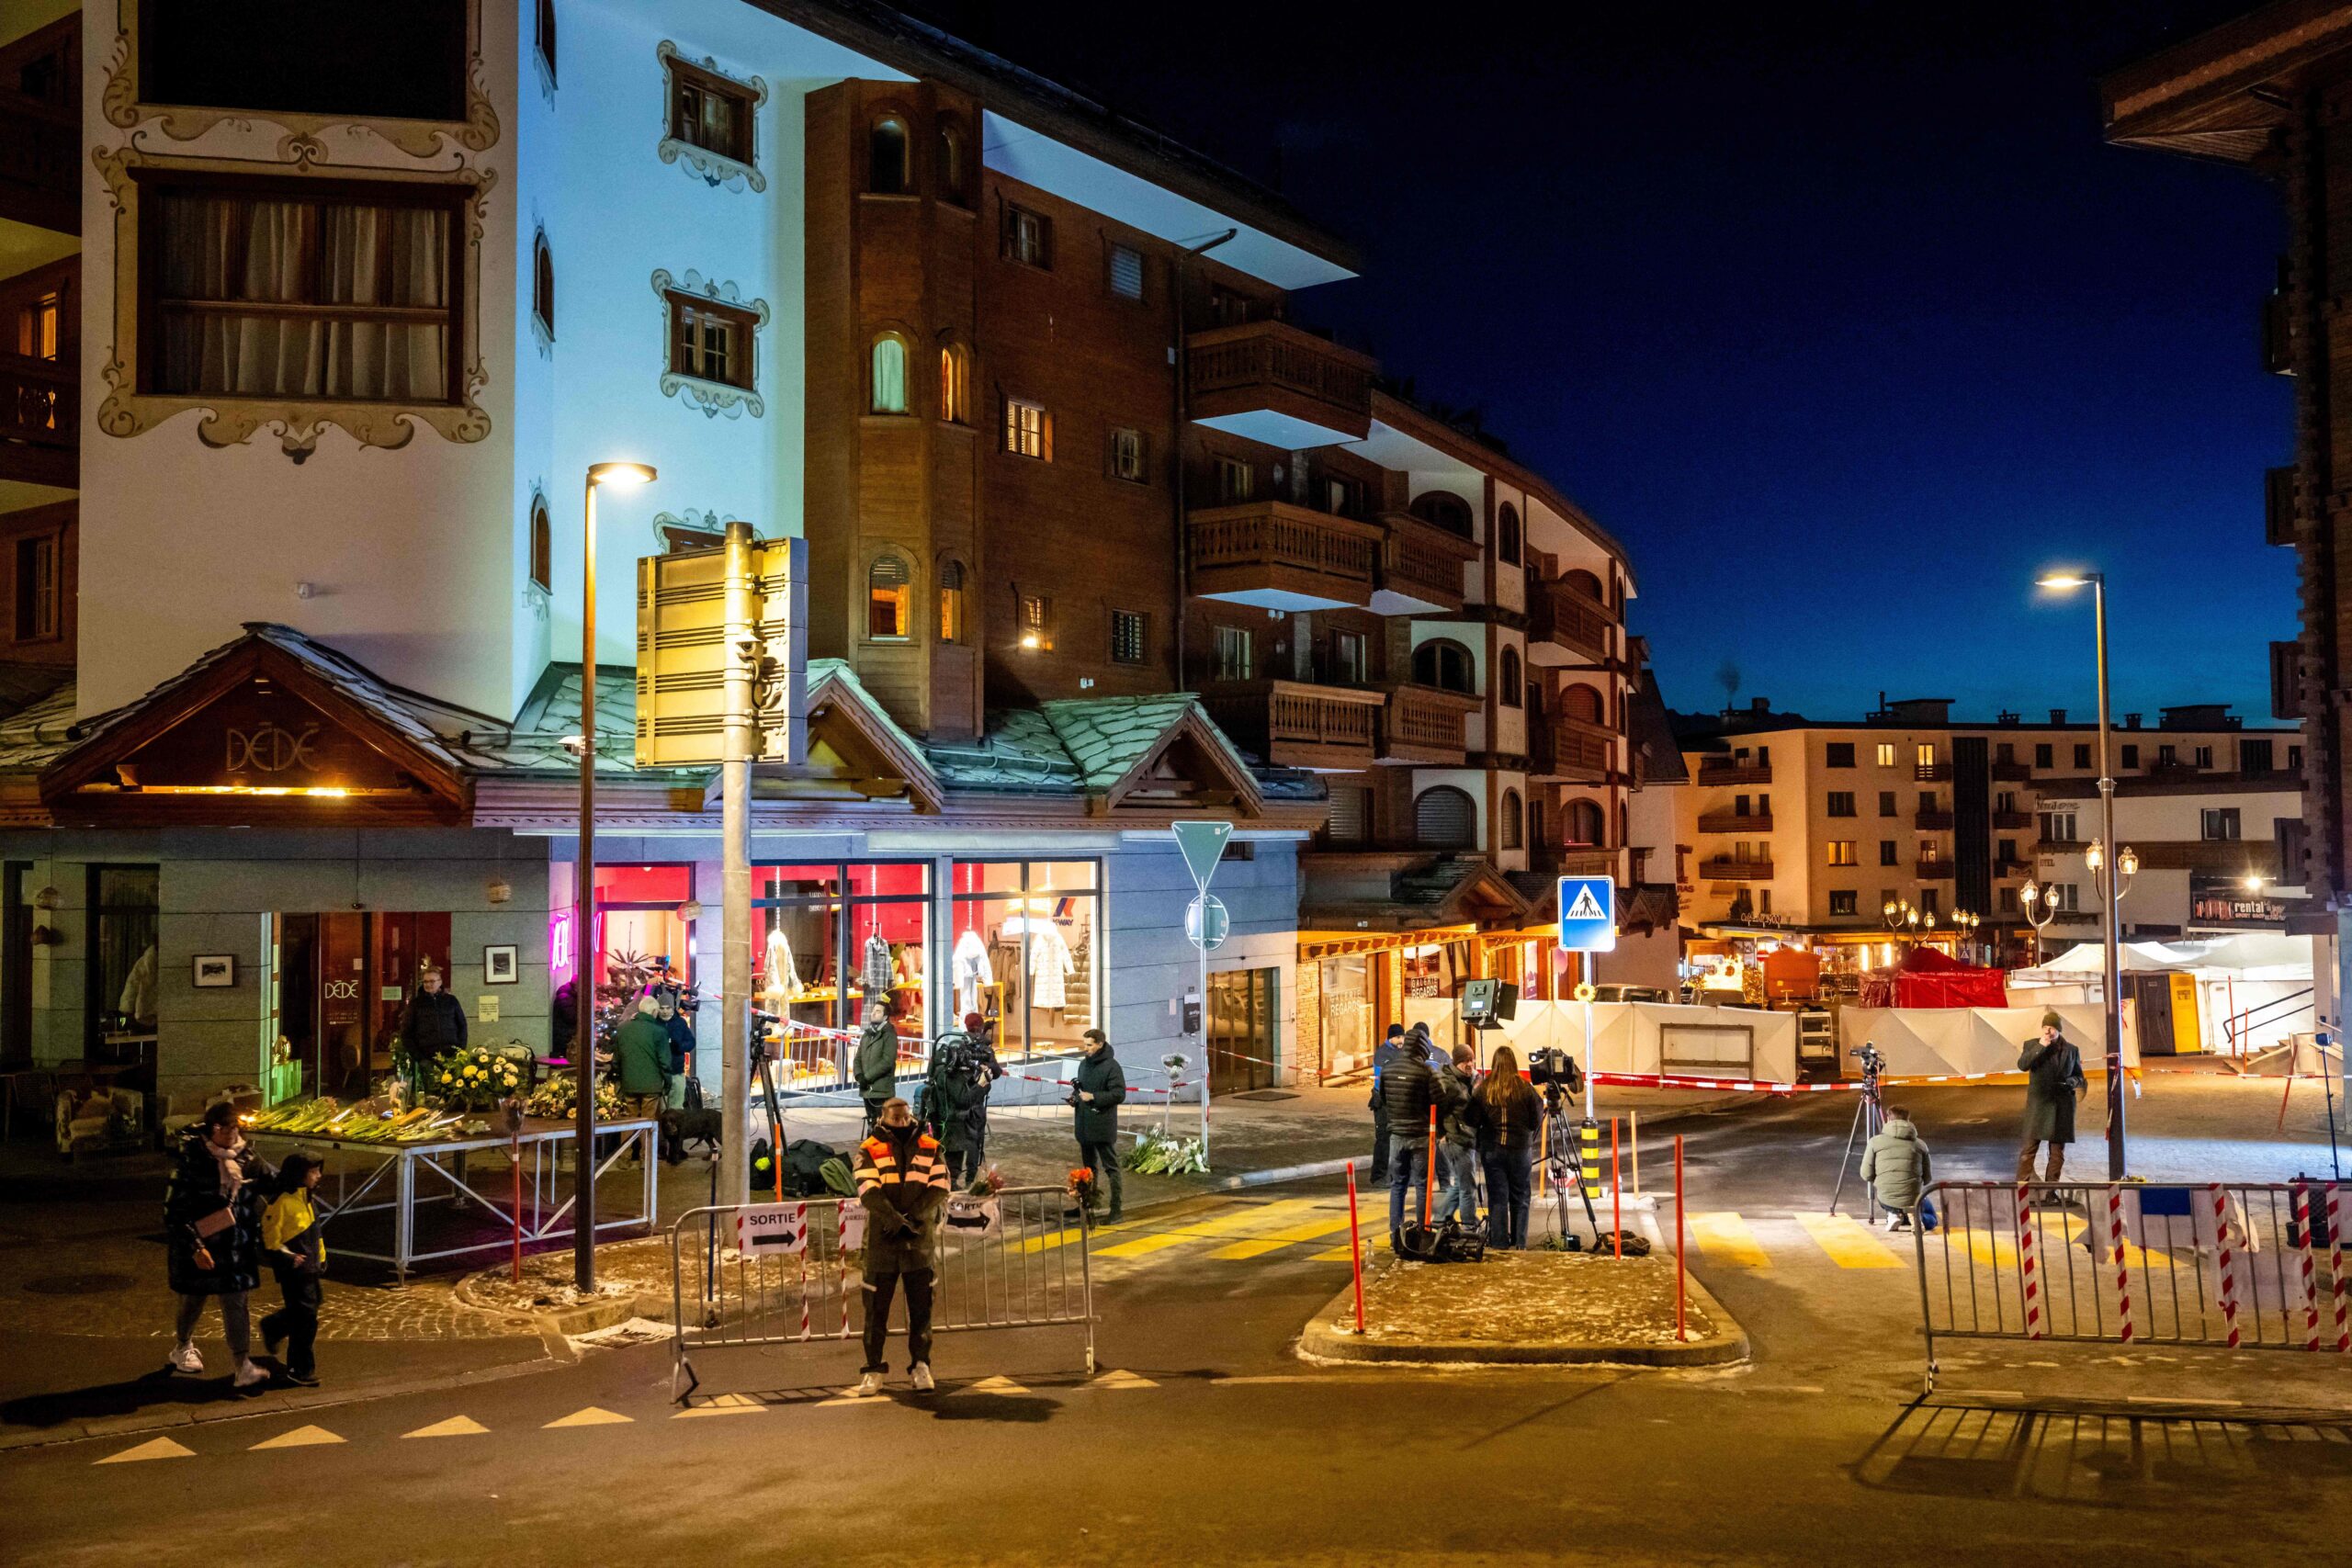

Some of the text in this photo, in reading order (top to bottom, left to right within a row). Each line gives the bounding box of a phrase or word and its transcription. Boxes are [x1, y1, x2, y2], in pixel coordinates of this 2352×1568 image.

[2234, 900, 2265, 913] rental
[1411, 976, 1438, 988] GALERIE
[1411, 985, 1438, 998] REGARDS
[1330, 1000, 1361, 1017] REGARDS
[750, 1213, 797, 1225] SORTIE
